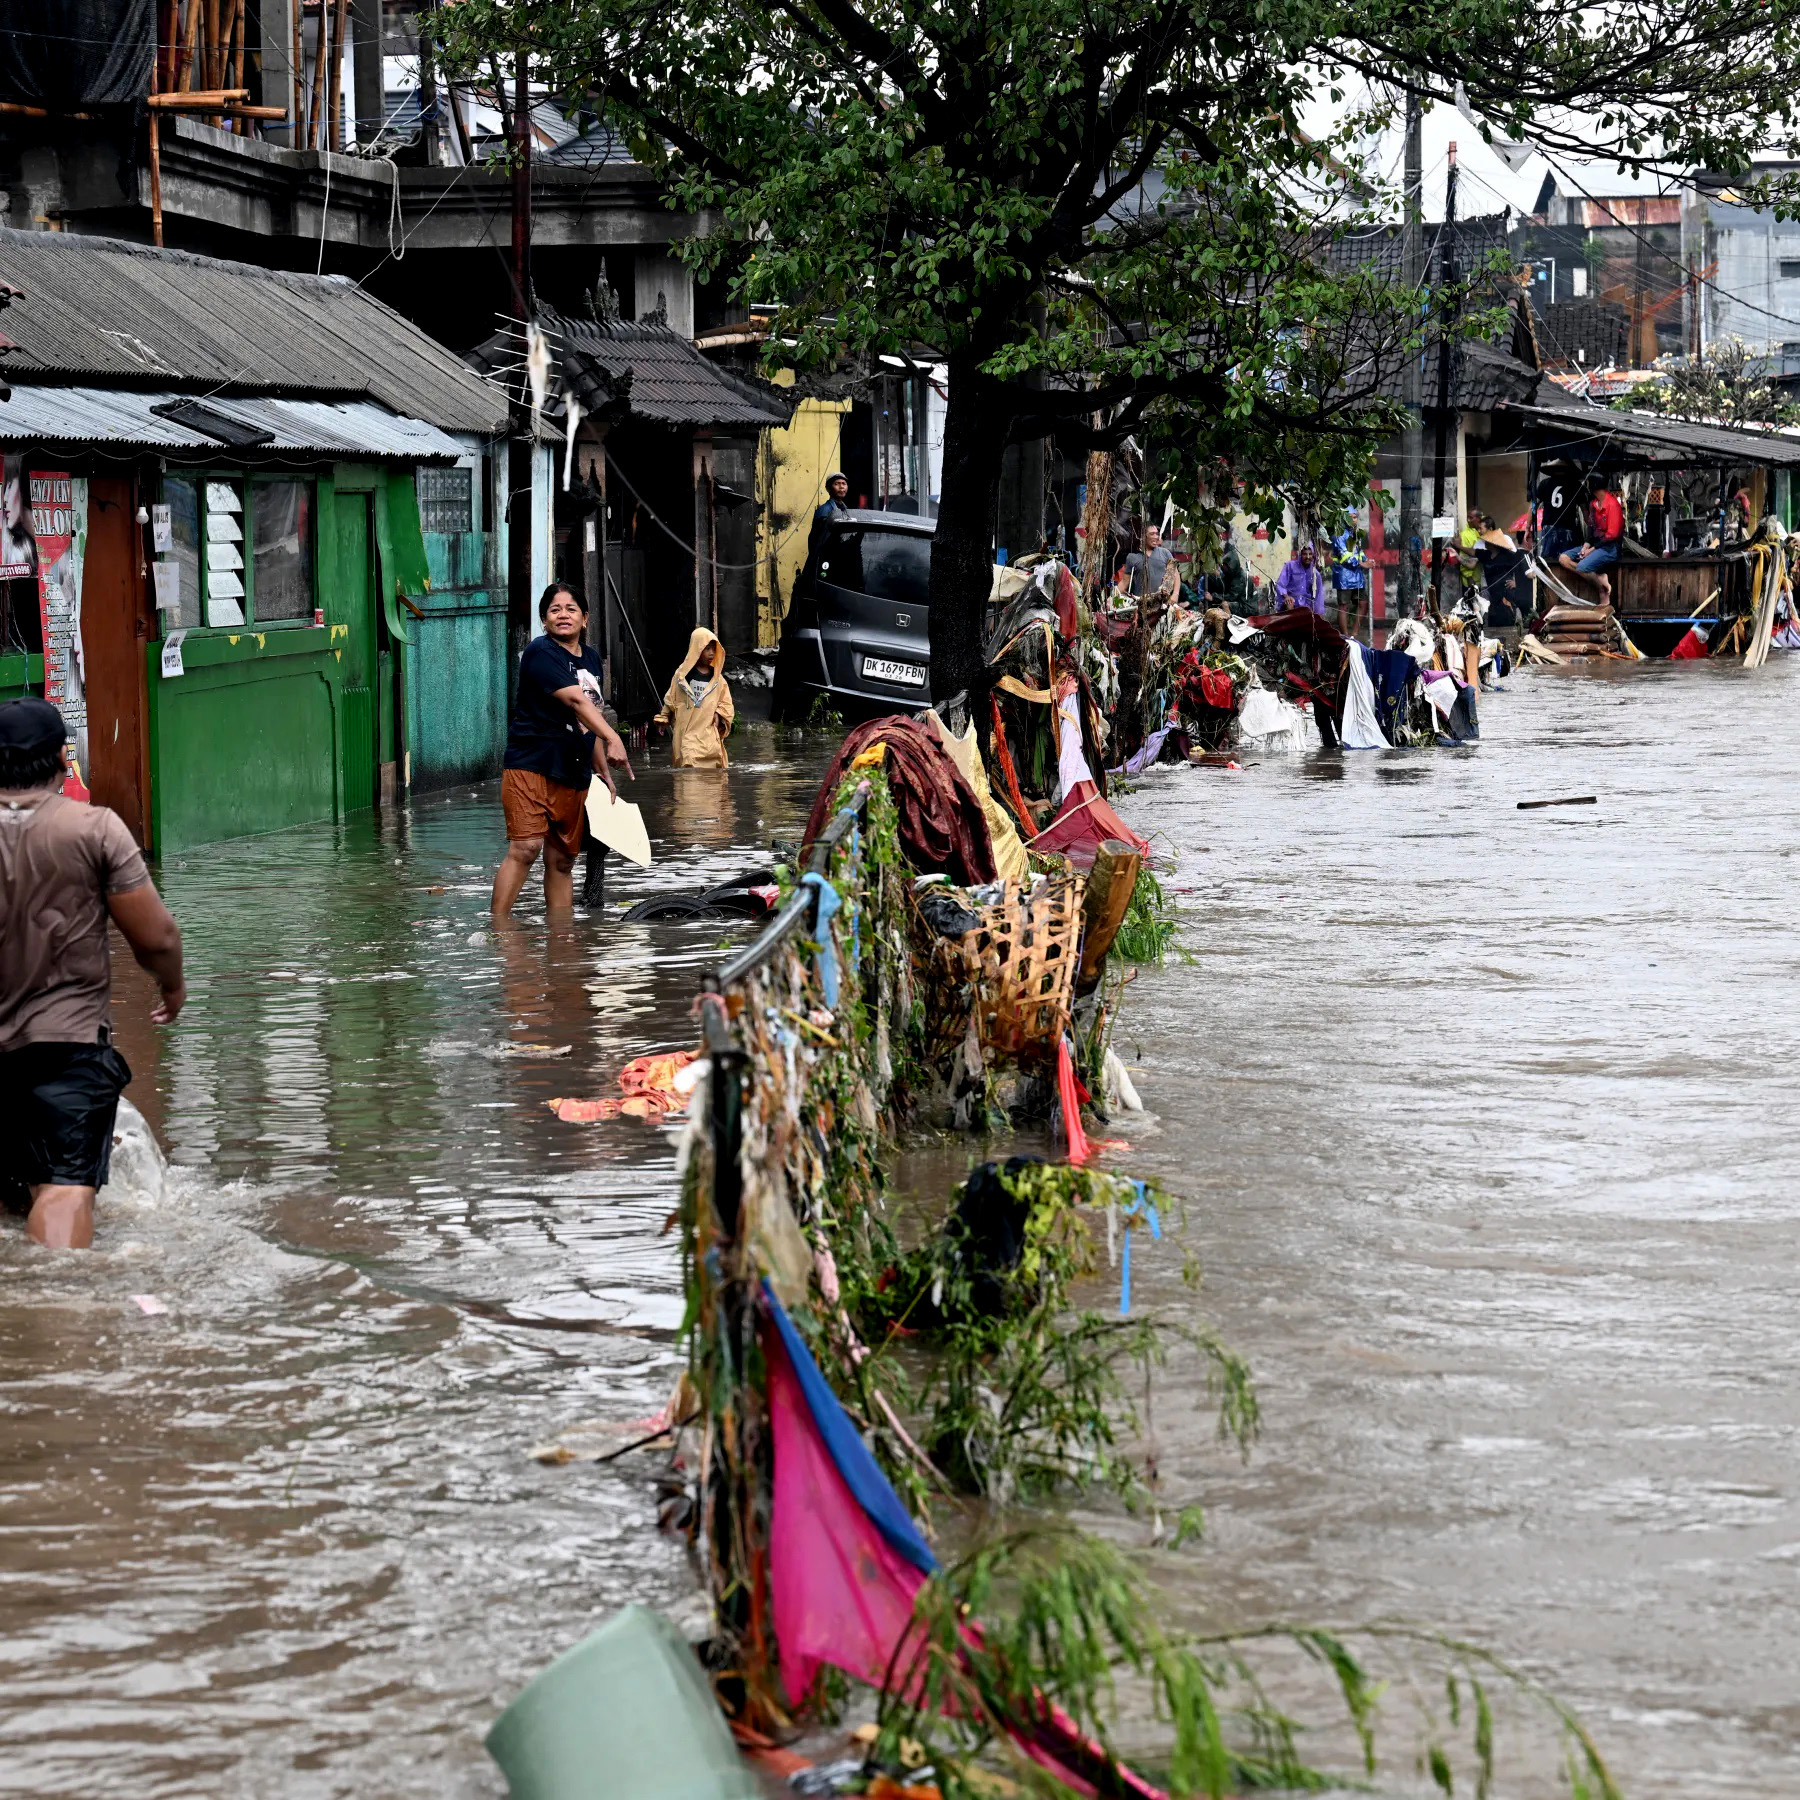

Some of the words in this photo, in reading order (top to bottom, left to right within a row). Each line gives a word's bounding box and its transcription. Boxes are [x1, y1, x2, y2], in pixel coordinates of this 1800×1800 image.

[1551, 485, 1563, 509] 6
[32, 508, 72, 537] SALON
[866, 659, 878, 671] DK
[880, 662, 904, 675] 1679
[905, 666, 925, 679] FBN
